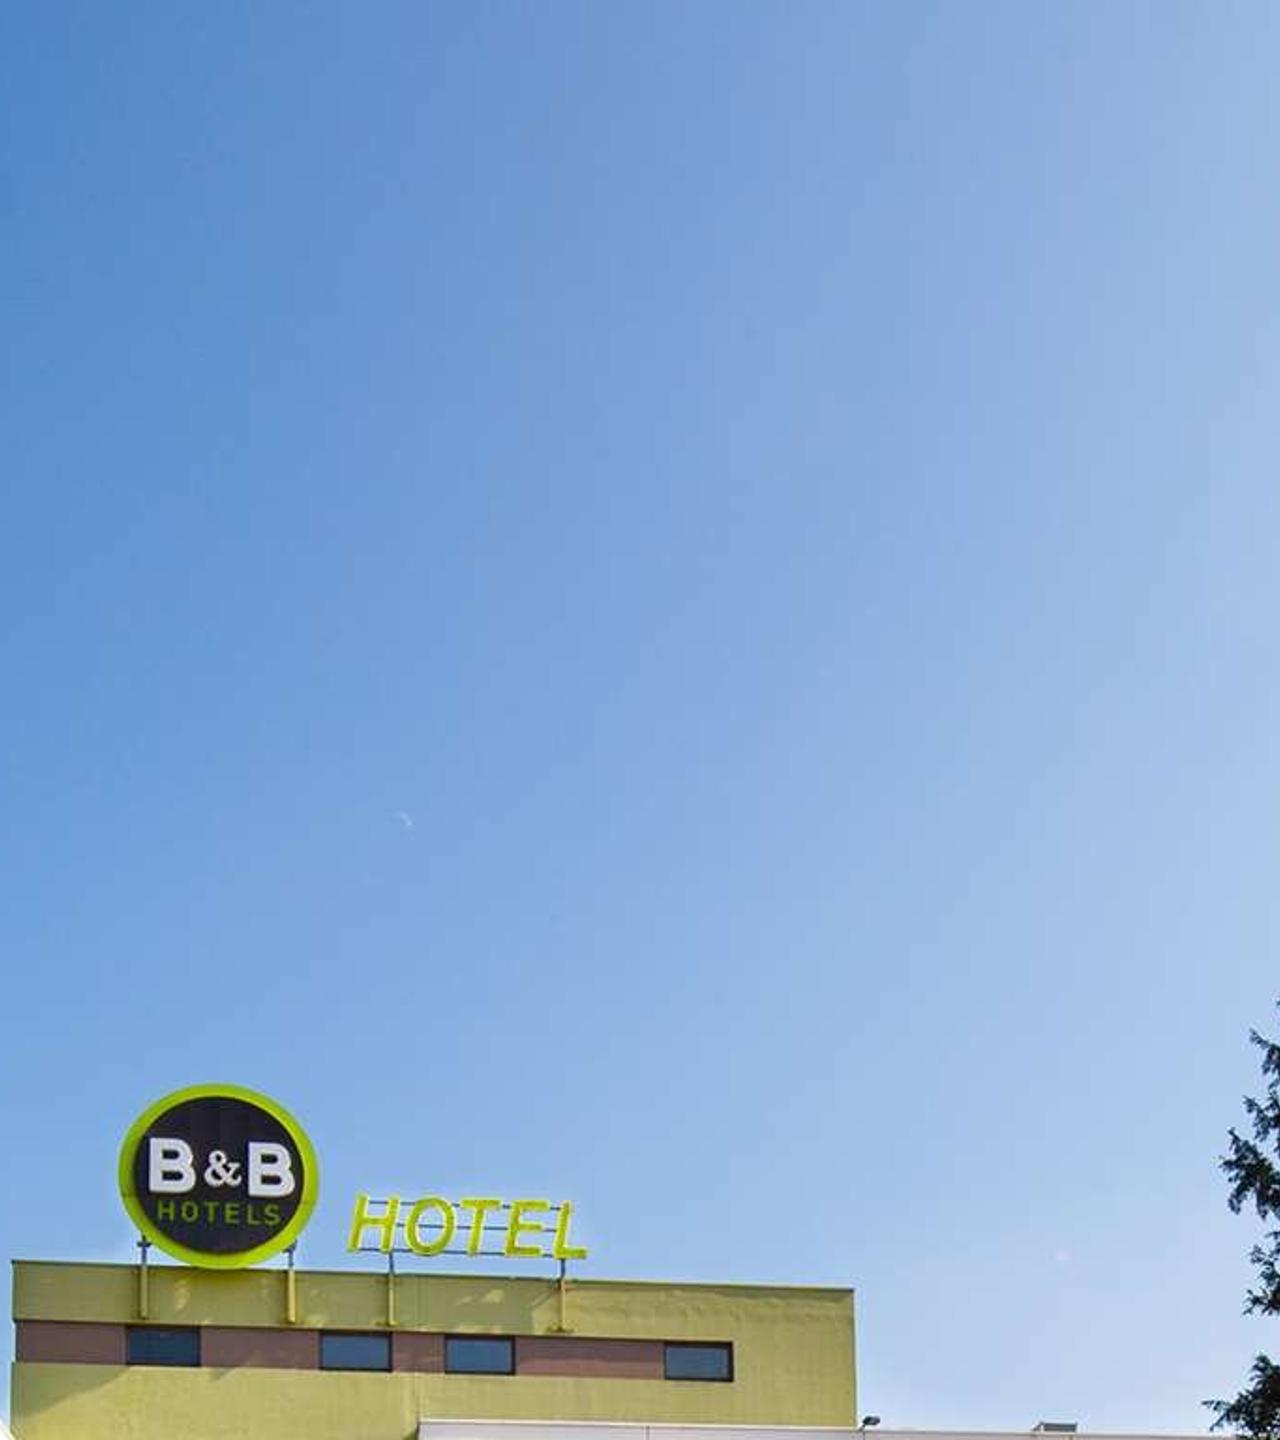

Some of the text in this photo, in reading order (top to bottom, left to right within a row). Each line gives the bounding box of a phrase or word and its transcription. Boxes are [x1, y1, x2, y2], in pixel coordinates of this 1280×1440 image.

[148, 1137, 297, 1198] B&B
[157, 1201, 282, 1226] HOTELS
[348, 1194, 588, 1259] HOTEL
